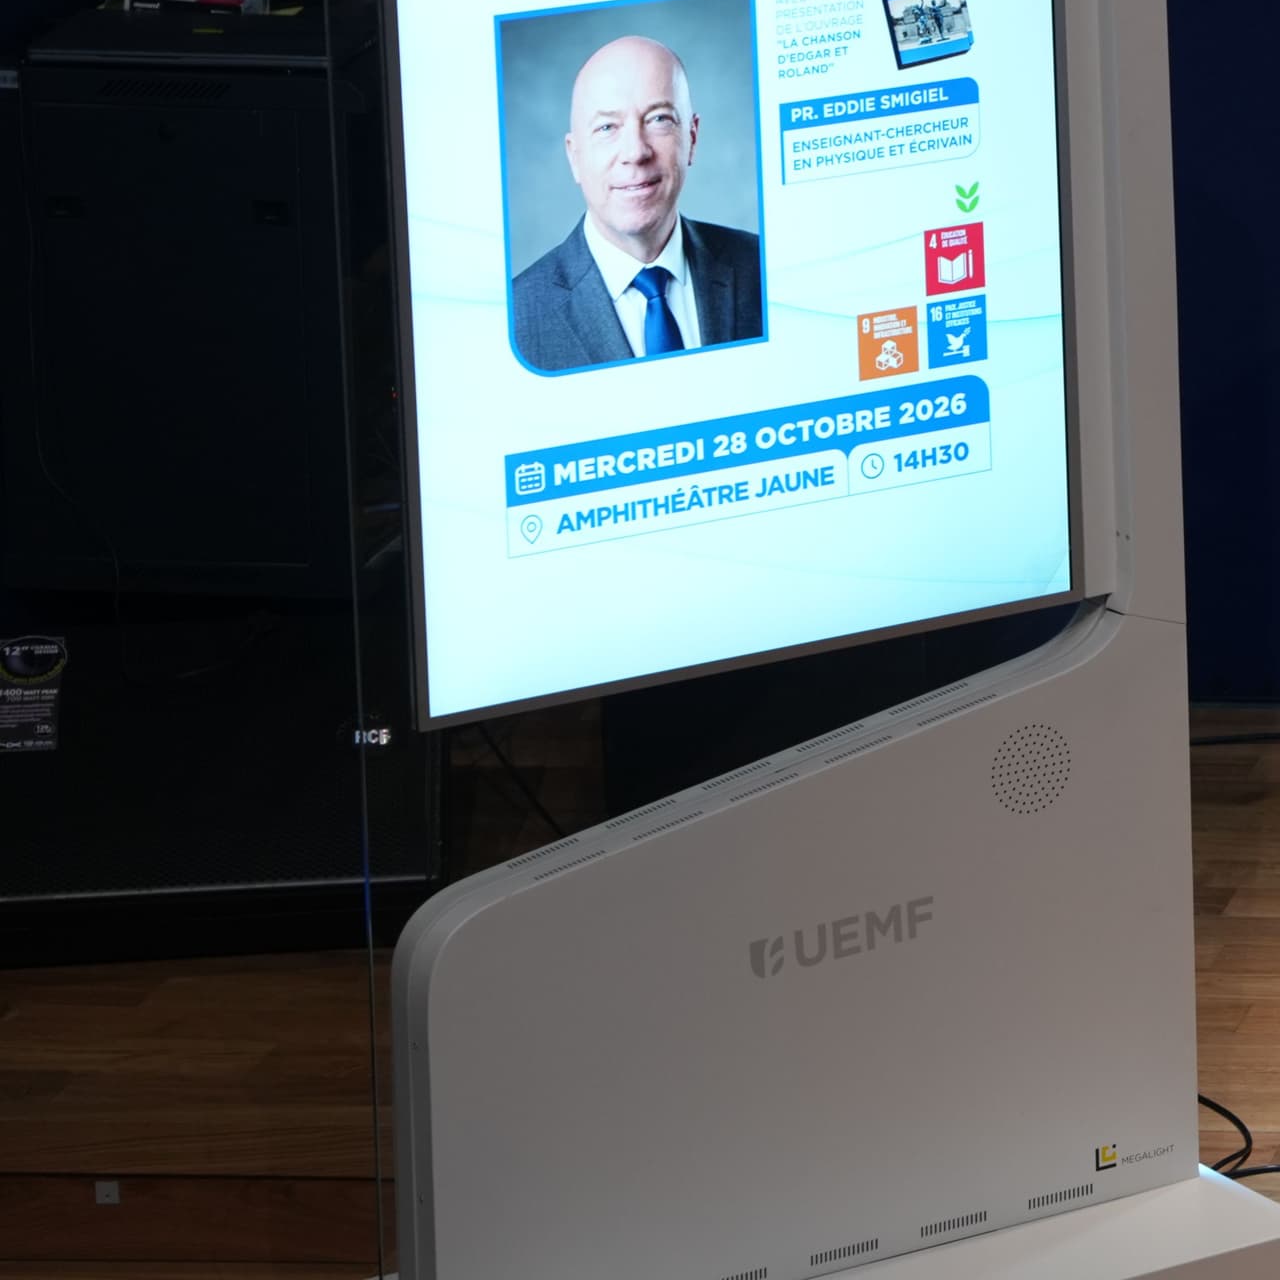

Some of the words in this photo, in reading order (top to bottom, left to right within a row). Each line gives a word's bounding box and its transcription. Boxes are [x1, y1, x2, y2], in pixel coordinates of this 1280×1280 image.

[802, 29, 861, 46] CHANSON
[778, 48, 831, 65] D'EDGAR
[835, 46, 849, 56] ET
[791, 107, 819, 122] PR.
[823, 97, 876, 118] EDDIE
[880, 87, 949, 109] SMIGIEL
[793, 117, 969, 153] ENSEIGNANT-CHERCHEUR
[793, 159, 812, 171] EN
[816, 147, 885, 168] PHYSIQUE
[889, 144, 905, 156] ET
[909, 134, 973, 154] ÉCRIVAIN
[929, 233, 938, 249] 4
[930, 306, 943, 322] 16
[554, 438, 705, 486] MERCREDI
[713, 432, 748, 459] 28
[755, 405, 891, 451] OCTOBRE
[899, 392, 967, 425] 2026
[893, 441, 970, 474] 14H30
[556, 485, 750, 535] AMPHITHÉÂTRE
[756, 465, 835, 498] JAUNE
[794, 896, 934, 968] UEMF
[1121, 1144, 1175, 1165] MEGALIGHT
